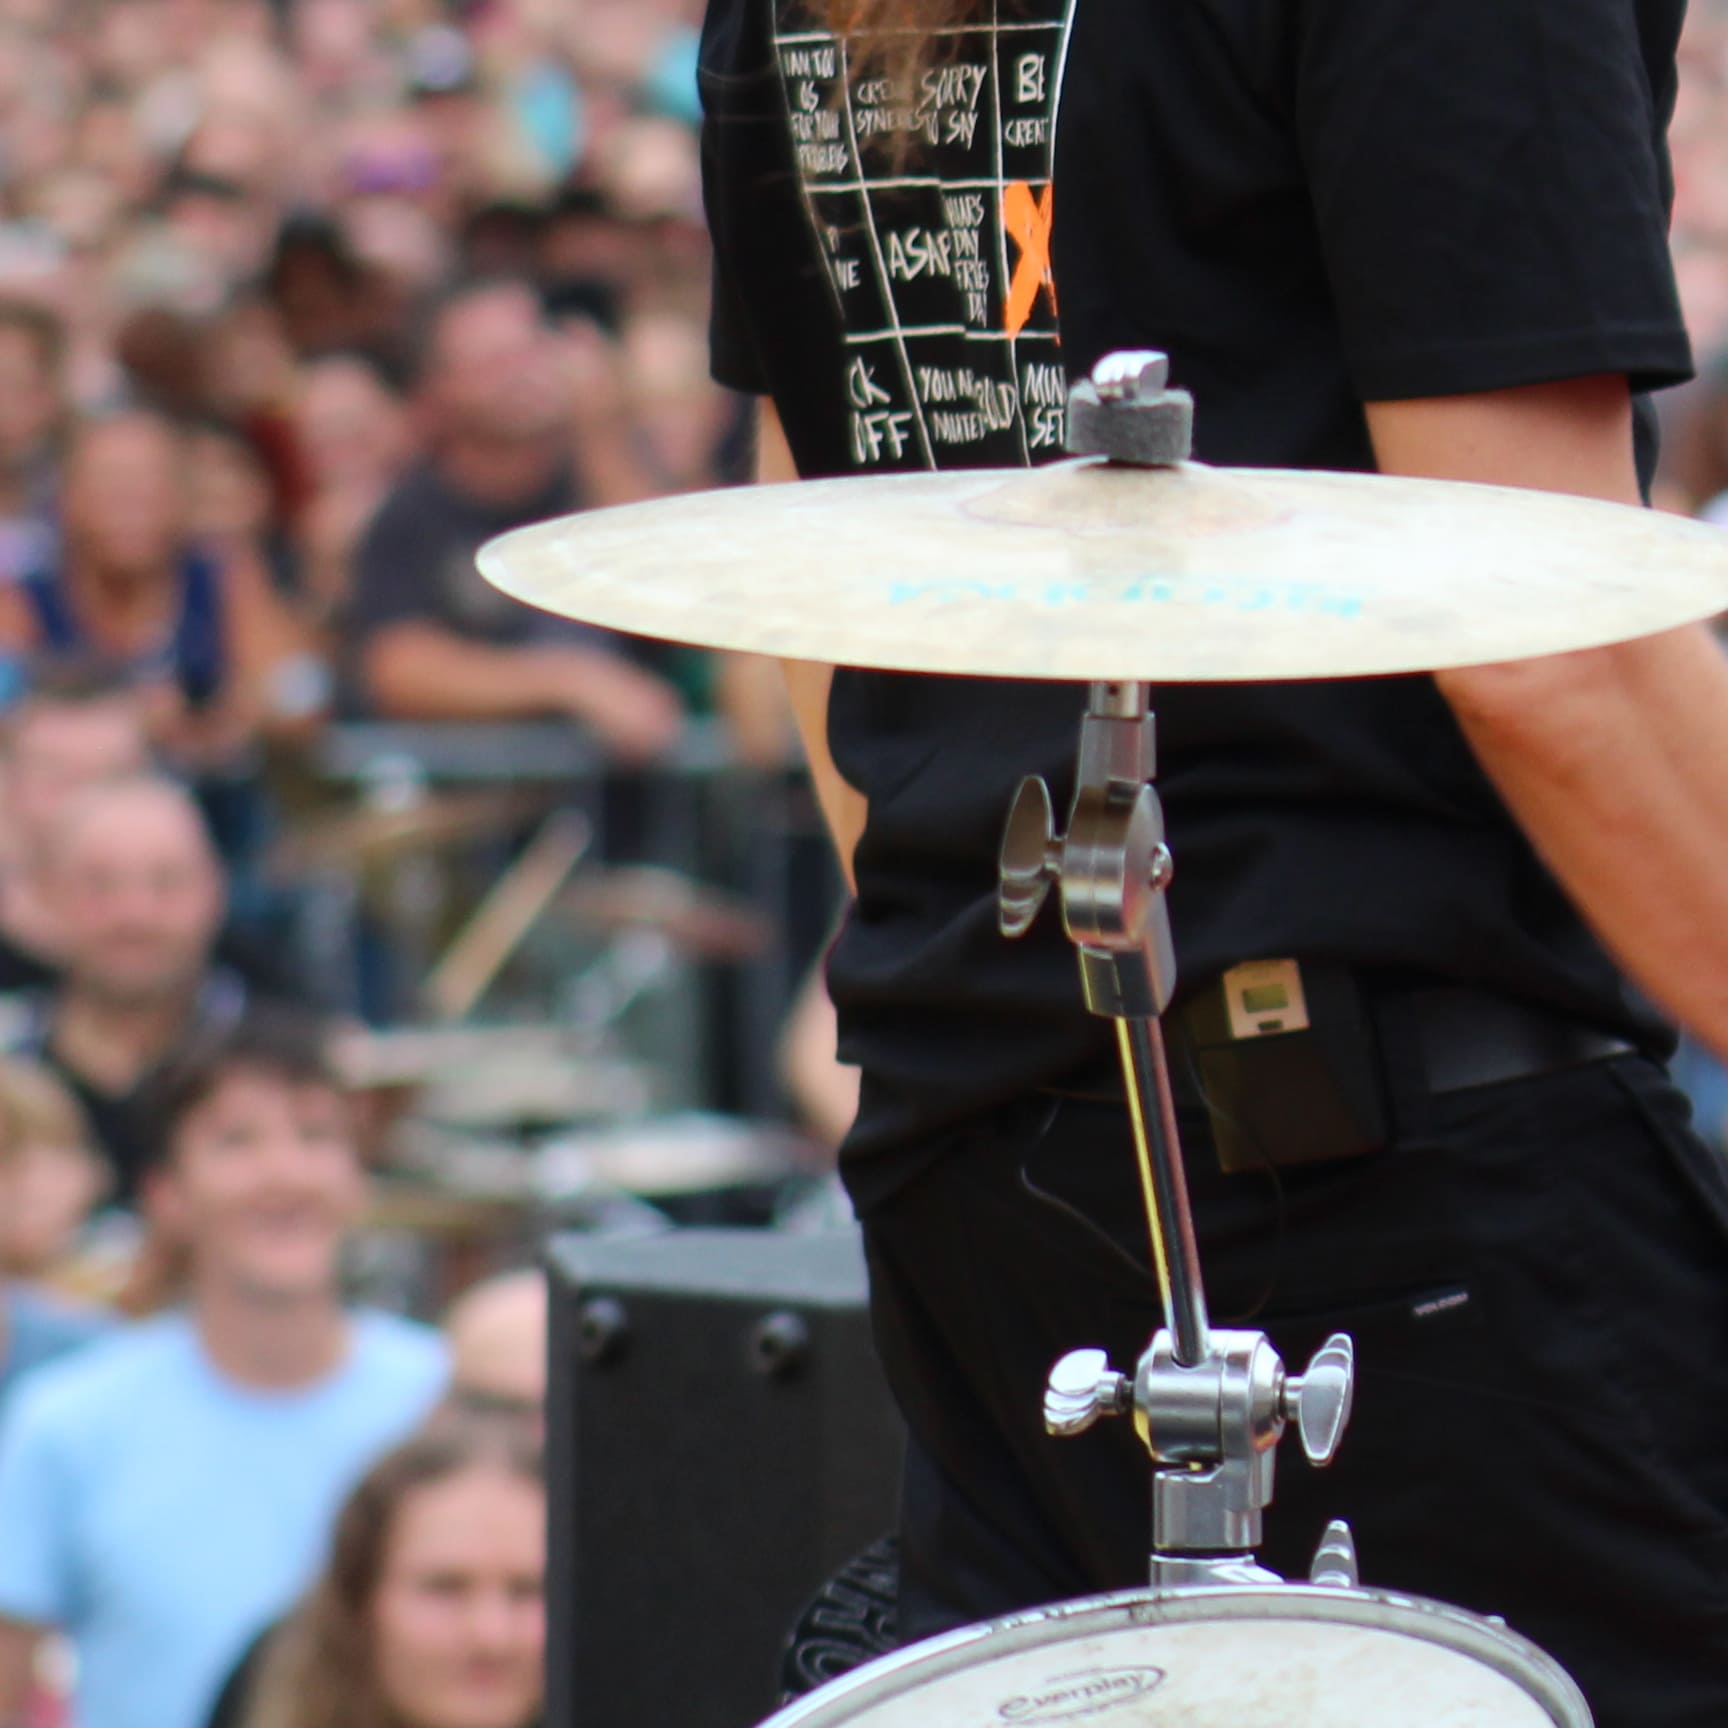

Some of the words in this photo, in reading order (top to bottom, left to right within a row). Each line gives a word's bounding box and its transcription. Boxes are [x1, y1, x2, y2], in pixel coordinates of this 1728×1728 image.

[914, 64, 988, 115] SORRY
[945, 110, 979, 151] SAY
[889, 227, 951, 281] ASAP
[920, 367, 957, 403] YOU
[1030, 407, 1065, 448] SET
